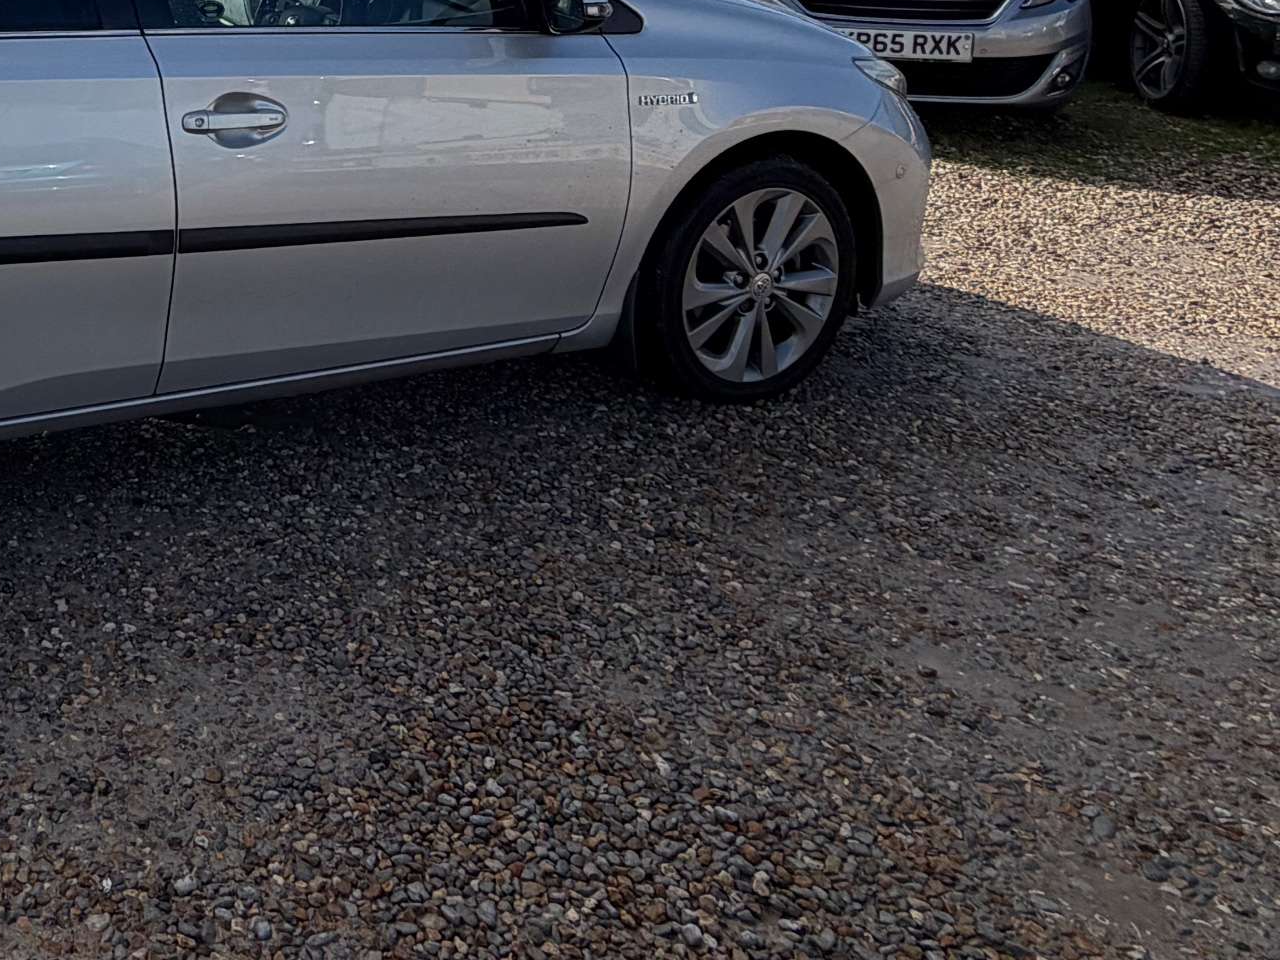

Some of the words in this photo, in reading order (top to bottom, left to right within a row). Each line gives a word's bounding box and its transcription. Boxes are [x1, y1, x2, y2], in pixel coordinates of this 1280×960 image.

[842, 31, 904, 53] P65
[912, 34, 962, 56] RXK
[639, 93, 689, 106] HYBRID
